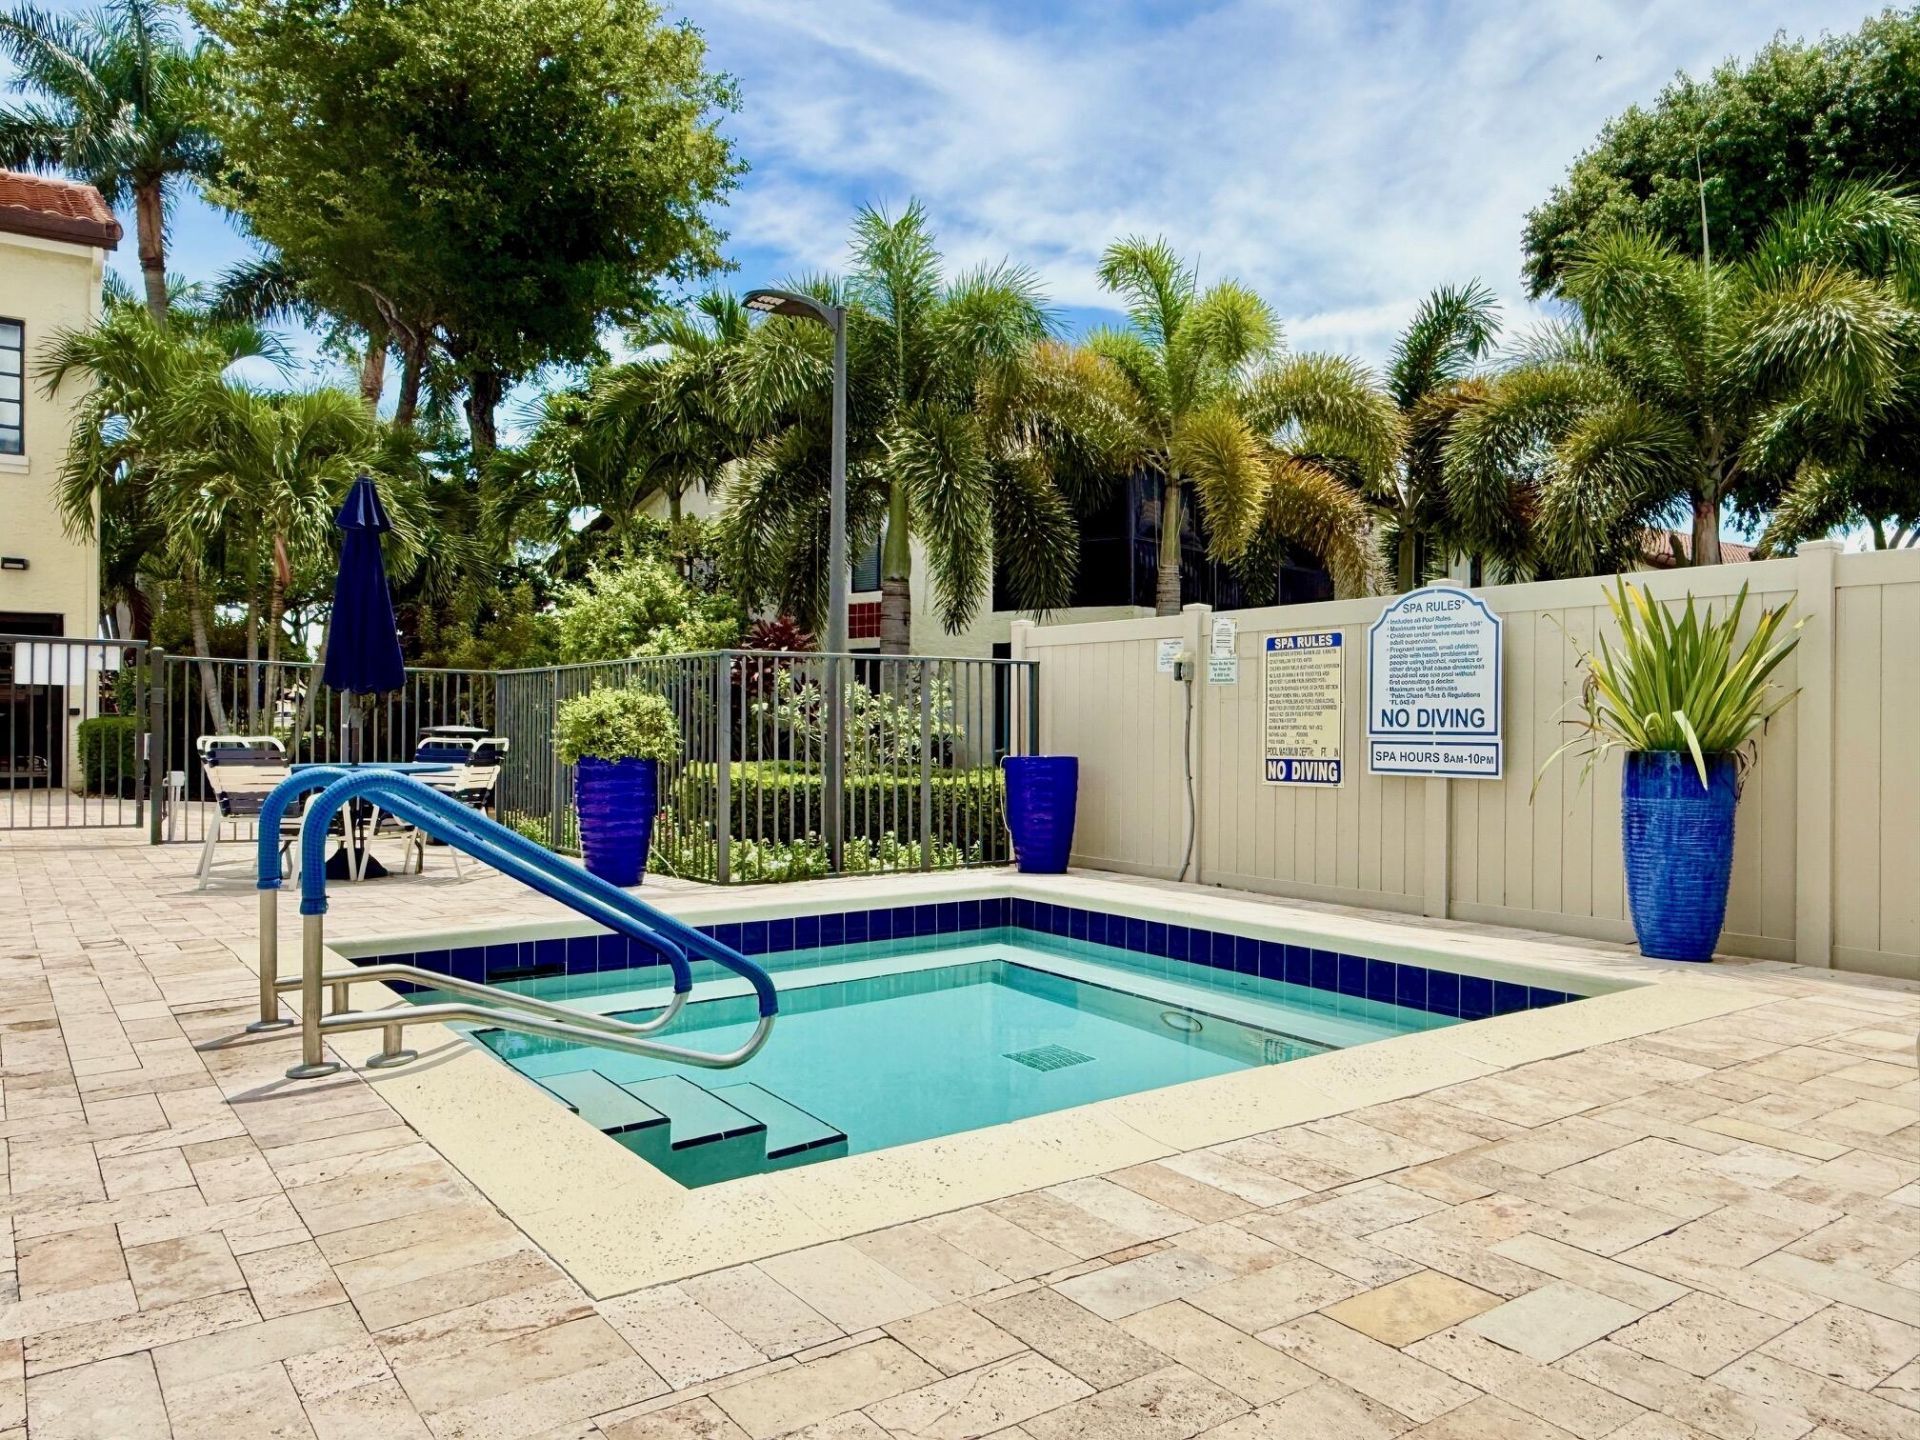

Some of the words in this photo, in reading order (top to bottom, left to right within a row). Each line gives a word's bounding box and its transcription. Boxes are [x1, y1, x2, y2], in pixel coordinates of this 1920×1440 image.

[1403, 603, 1422, 613] SPA
[1275, 637, 1294, 649] SPA
[1297, 634, 1332, 648] RULES
[1382, 708, 1410, 728] NO
[1417, 708, 1485, 728] DIVING
[1376, 752, 1396, 762] SPA
[1400, 752, 1440, 763] HOURS
[1444, 753, 1494, 764] 8AM-10PM
[1268, 761, 1286, 779] NO
[1292, 761, 1338, 781] DIVING
